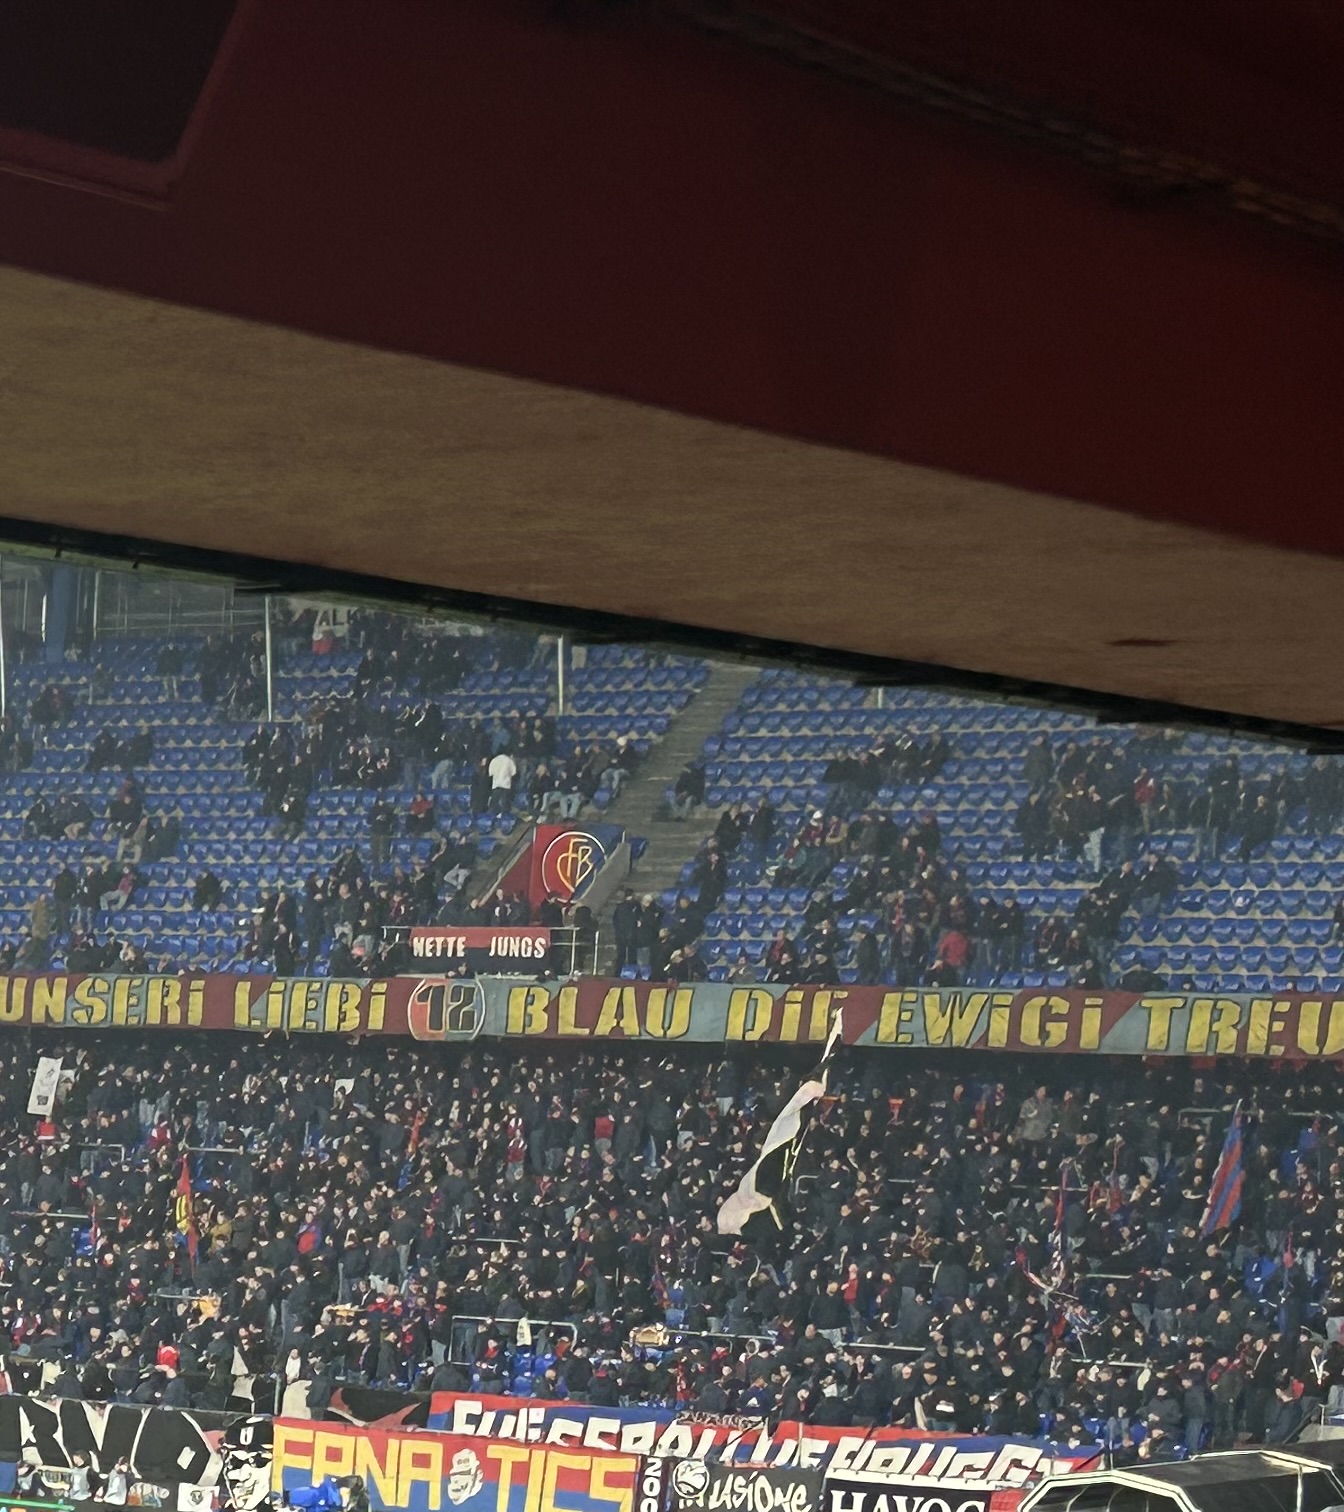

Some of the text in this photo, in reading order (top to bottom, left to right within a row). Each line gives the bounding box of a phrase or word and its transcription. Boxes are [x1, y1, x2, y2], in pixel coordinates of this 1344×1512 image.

[412, 935, 548, 960] NETTE JUNGS
[506, 984, 696, 1038] BLAU
